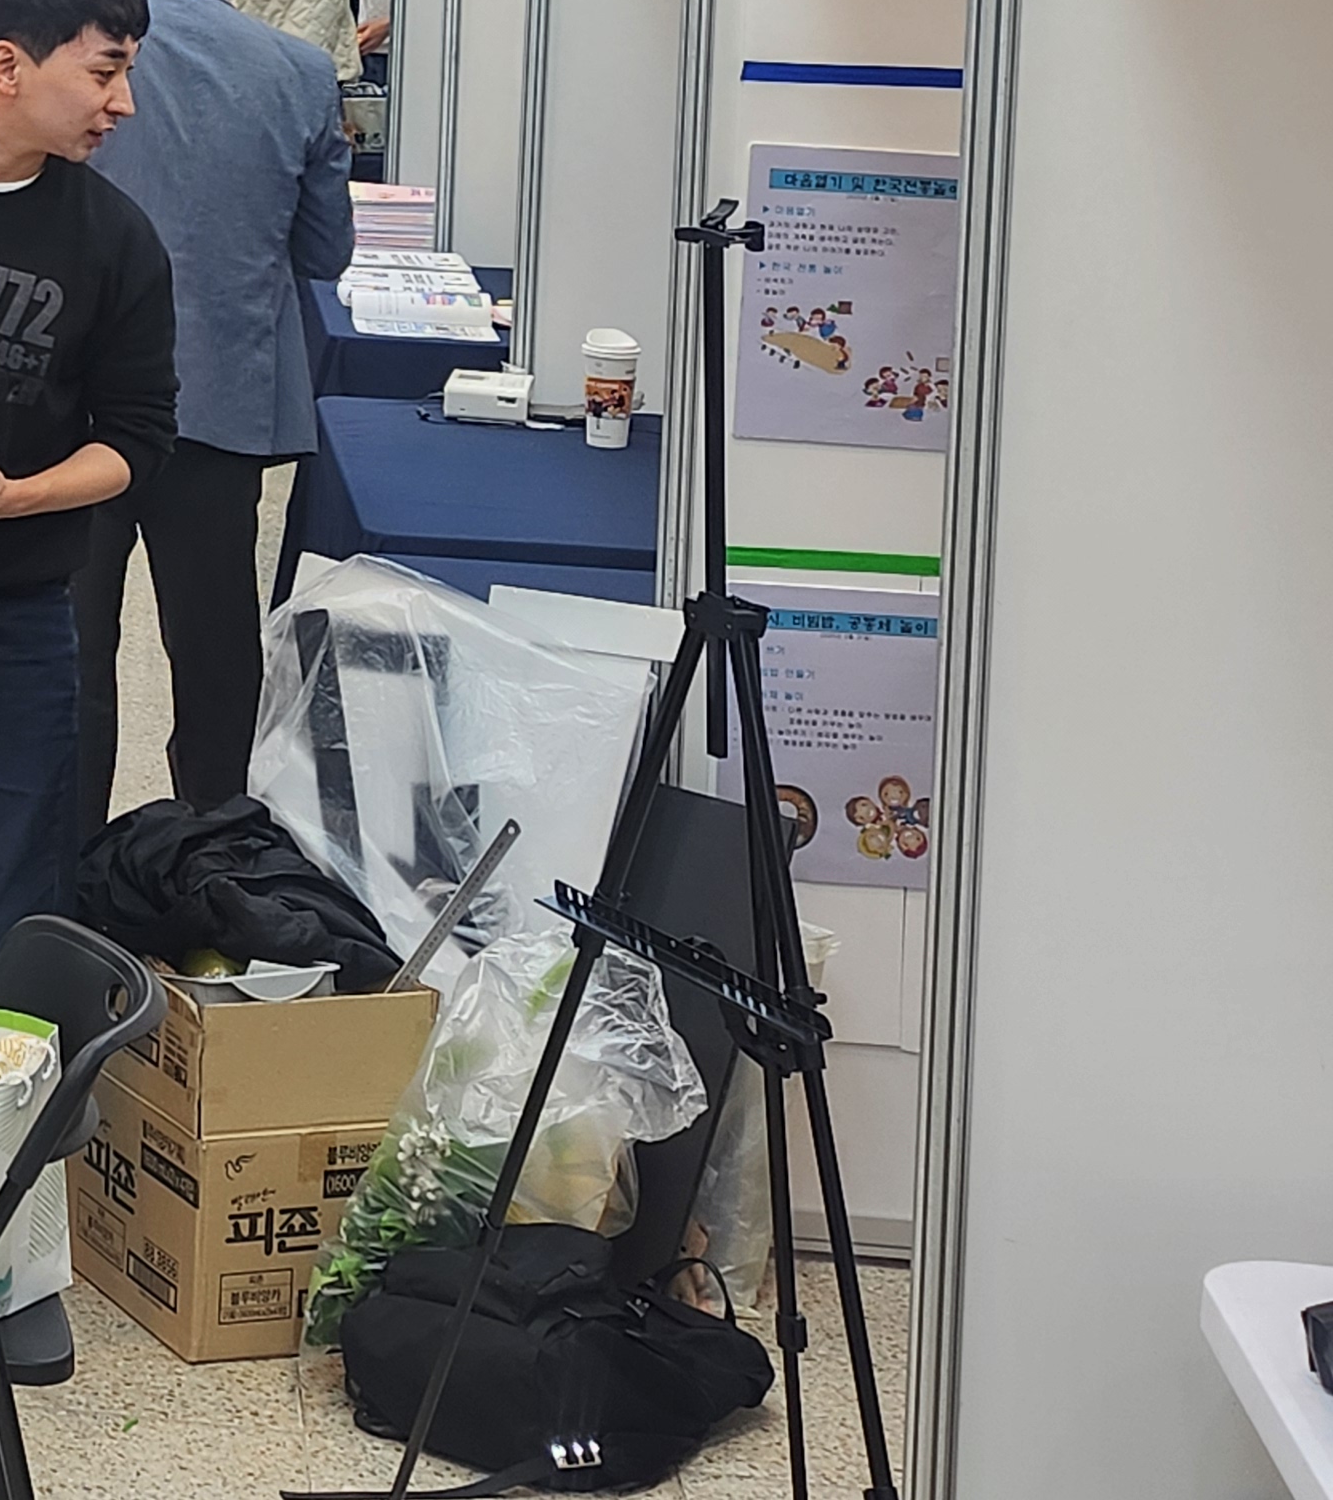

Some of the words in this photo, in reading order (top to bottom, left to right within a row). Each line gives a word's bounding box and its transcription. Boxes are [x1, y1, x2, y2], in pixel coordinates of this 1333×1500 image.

[784, 173, 843, 190] 마음열기
[851, 175, 865, 191] 및
[899, 619, 929, 635] 놀이
[84, 1135, 137, 1215] 피죤
[224, 1206, 322, 1257] 피죤
